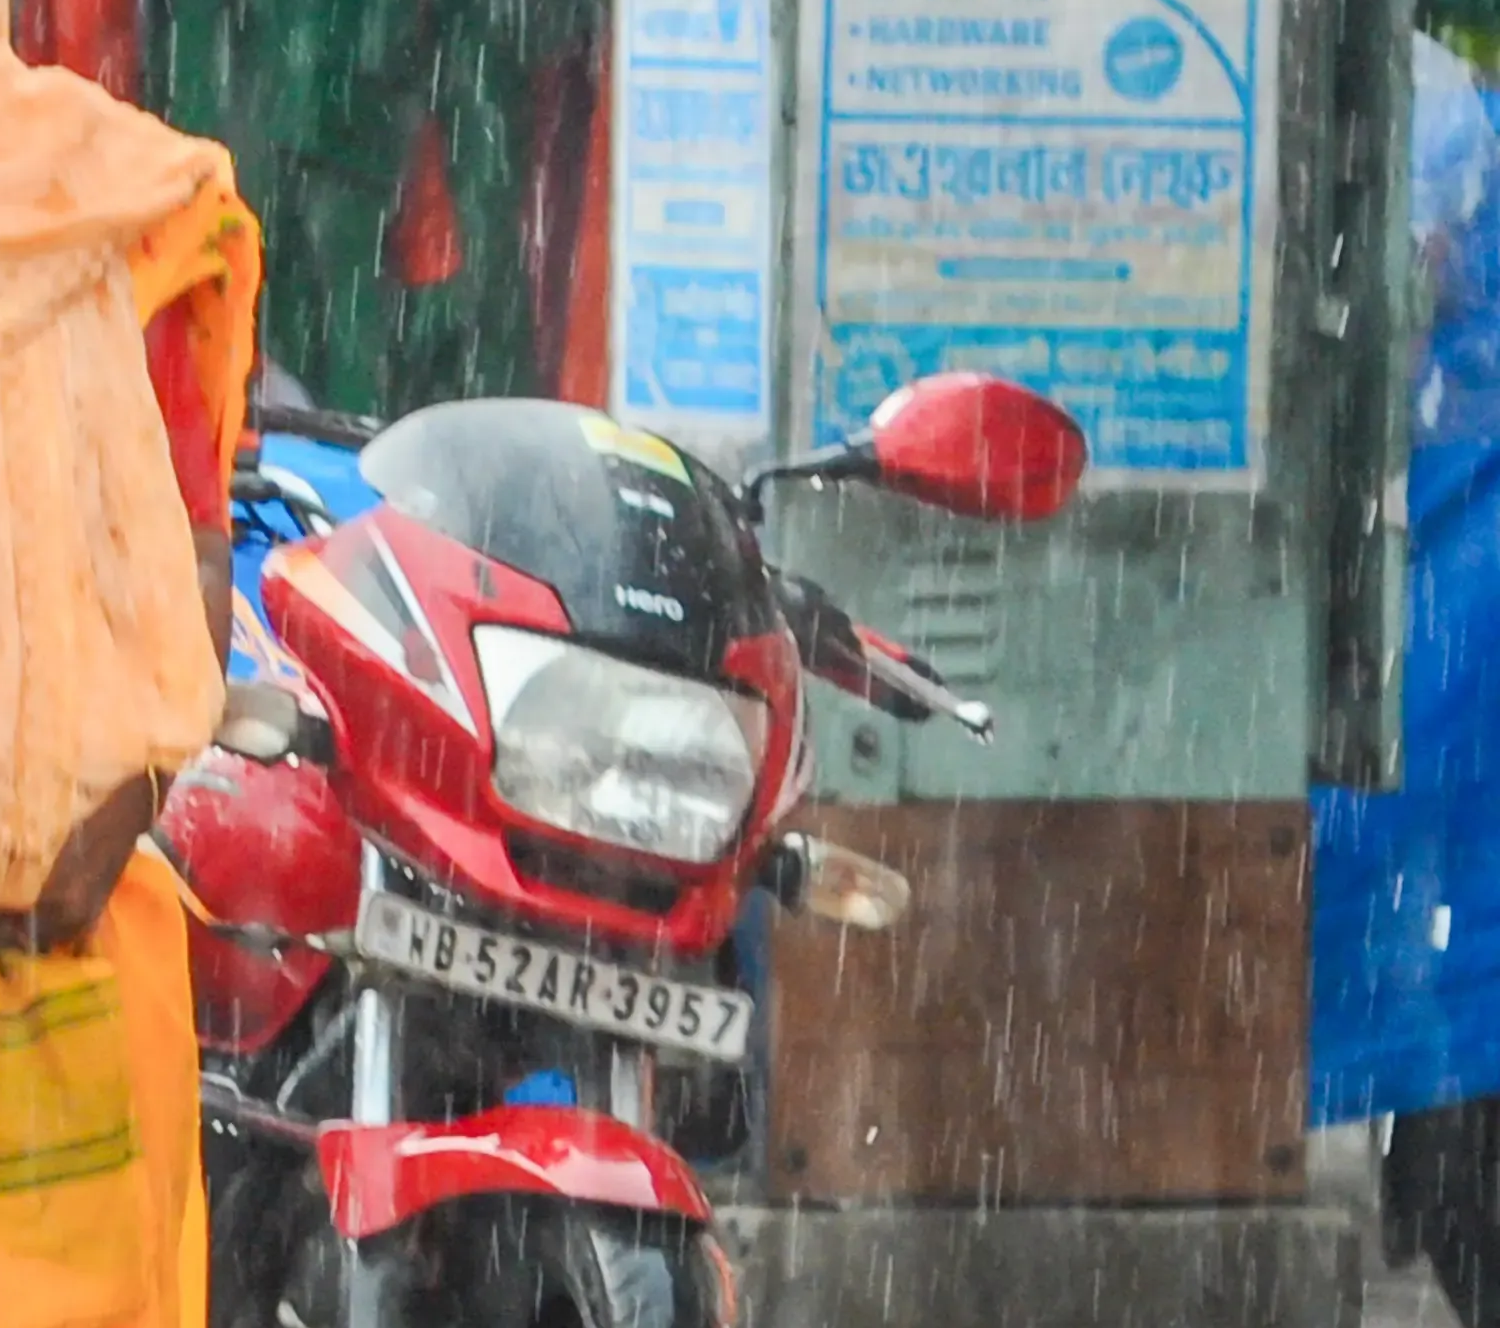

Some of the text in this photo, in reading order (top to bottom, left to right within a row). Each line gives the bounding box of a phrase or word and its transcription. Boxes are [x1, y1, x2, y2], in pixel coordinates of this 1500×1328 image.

[869, 15, 1051, 46] HARDWARE
[866, 64, 1083, 98] NETWORKING
[614, 583, 685, 622] Hero
